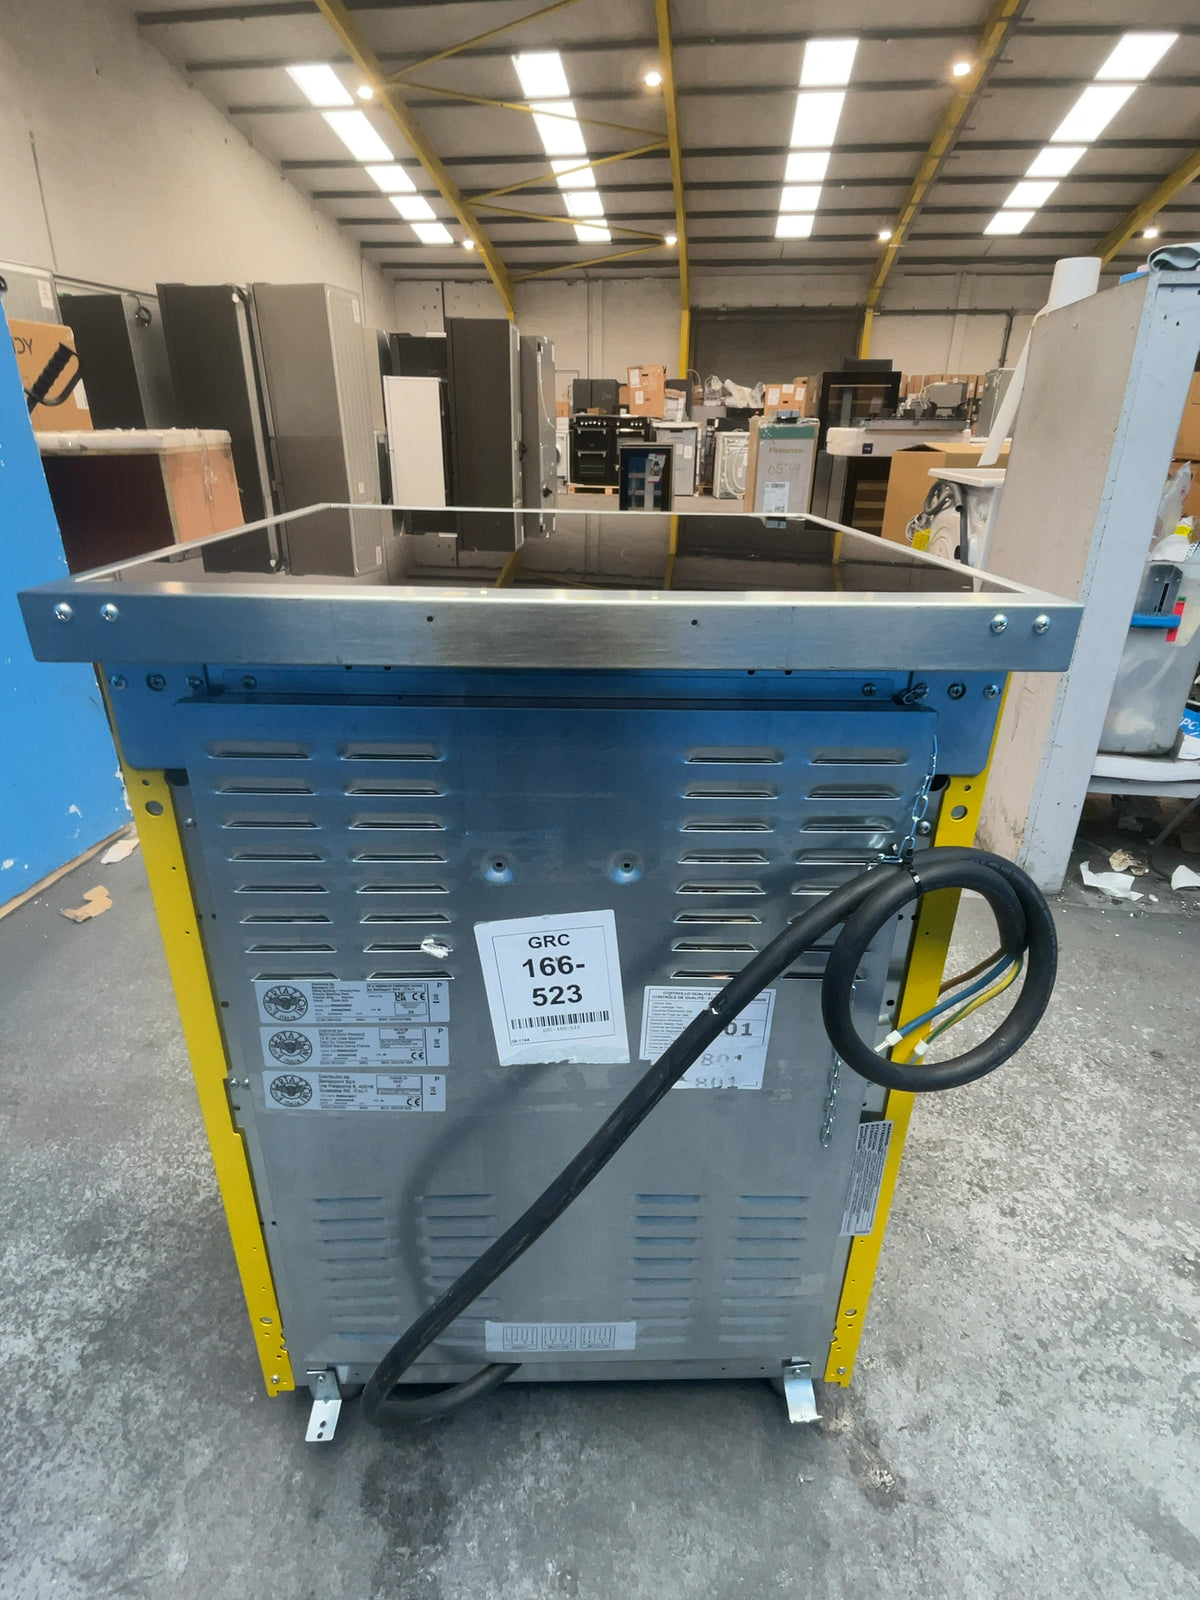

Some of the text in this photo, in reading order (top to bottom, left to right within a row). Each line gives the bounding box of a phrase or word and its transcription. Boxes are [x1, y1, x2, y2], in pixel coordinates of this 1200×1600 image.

[528, 934, 570, 949] GRC
[522, 955, 585, 978] 166-
[532, 984, 583, 1007] 523
